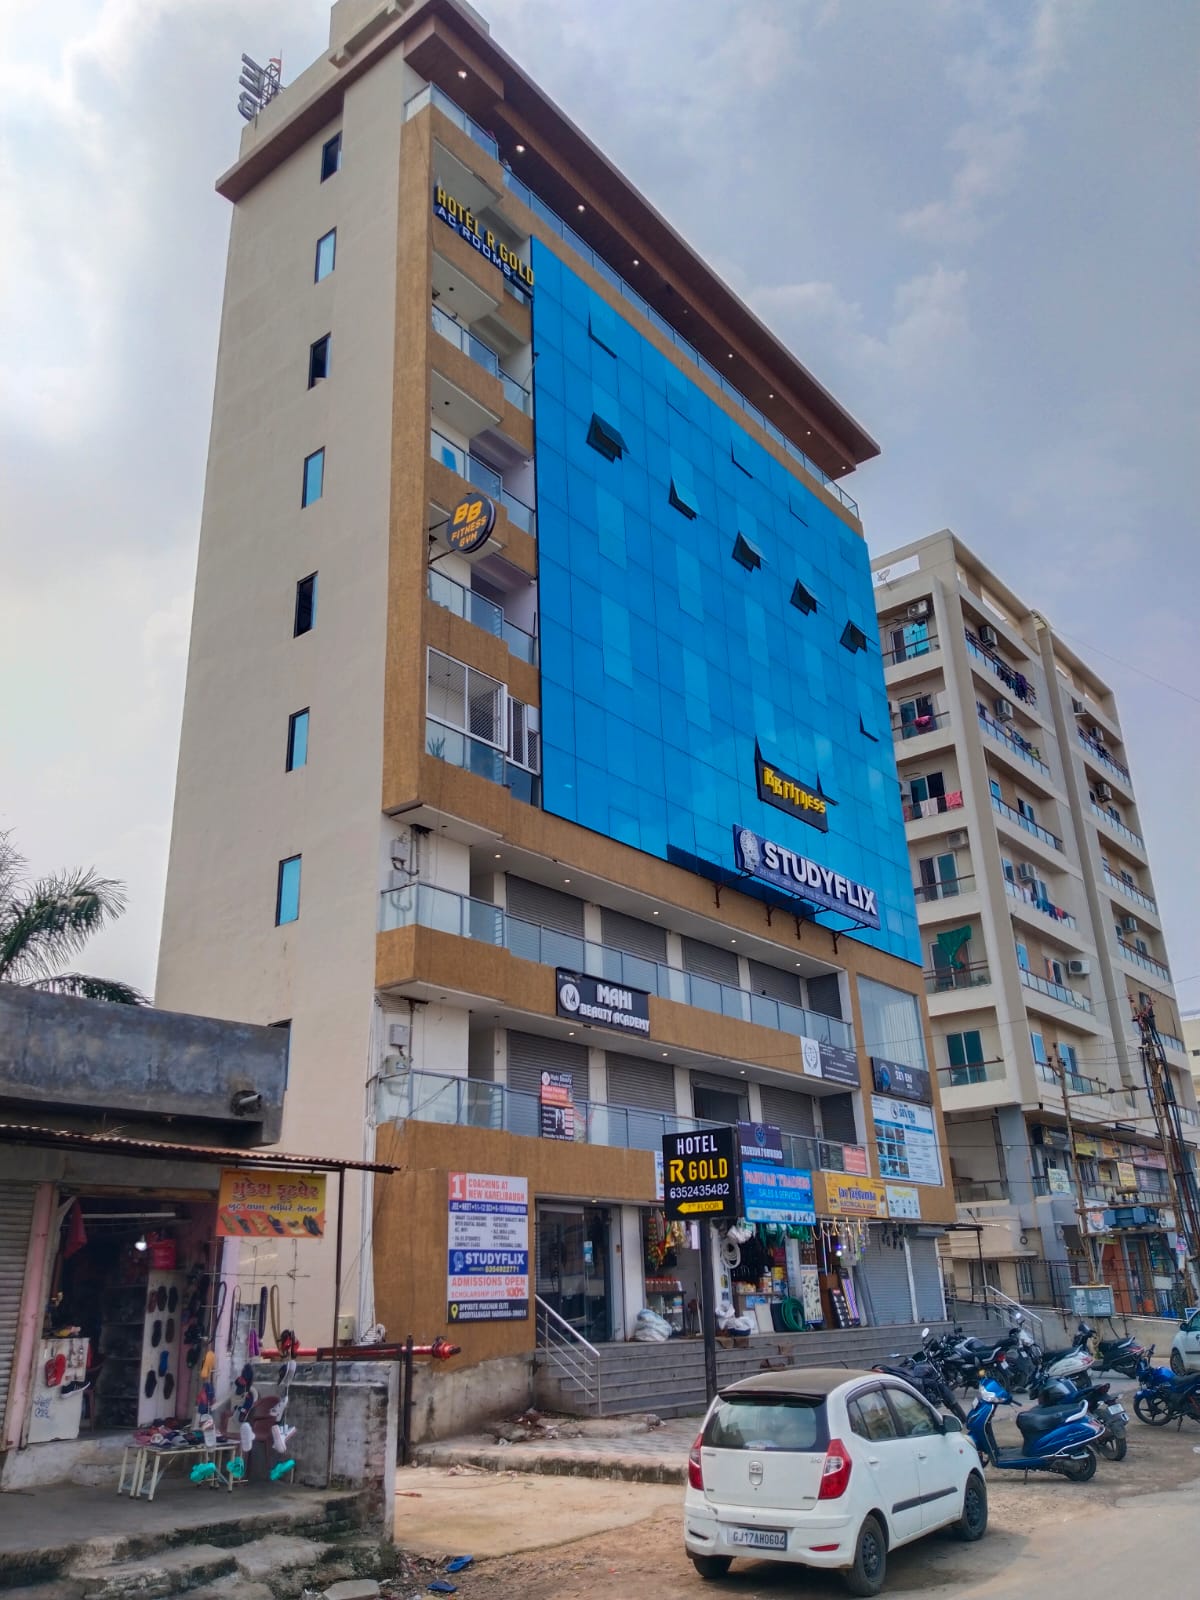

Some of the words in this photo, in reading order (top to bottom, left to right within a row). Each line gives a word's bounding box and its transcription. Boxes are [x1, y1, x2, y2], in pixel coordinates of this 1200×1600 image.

[437, 186, 482, 240] HOTEL
[487, 230, 495, 252] R
[500, 244, 534, 286] GOLD
[438, 207, 457, 228] AC
[462, 225, 511, 276] ROOMS
[453, 501, 483, 525] BB
[451, 515, 487, 541] FITNESS
[764, 842, 877, 915] STUDYFLIX
[596, 984, 633, 1010] MAHI
[579, 1003, 612, 1022] BEAUTY
[612, 1012, 650, 1032] ACADEMY
[676, 1135, 718, 1156] HOTEL
[669, 1159, 686, 1184] R
[689, 1158, 728, 1181] GOLD
[469, 1179, 499, 1189] COACHING
[501, 1181, 508, 1189] AT
[670, 1183, 730, 1199] 6352435482
[469, 1190, 482, 1199] NEW
[484, 1191, 525, 1201] KARELIBAUGH
[759, 1188, 773, 1198] SALES
[779, 1191, 801, 1201] SERVICES
[697, 1202, 720, 1210] FLOOR
[465, 1252, 525, 1265] STUDYFLIX
[451, 1277, 502, 1287] ADMISSIONS
[505, 1276, 526, 1286] OPEN
[506, 1287, 525, 1297] 100%
[460, 1303, 479, 1311] OPPOSITE
[733, 1531, 785, 1546] GJ17AH0604
